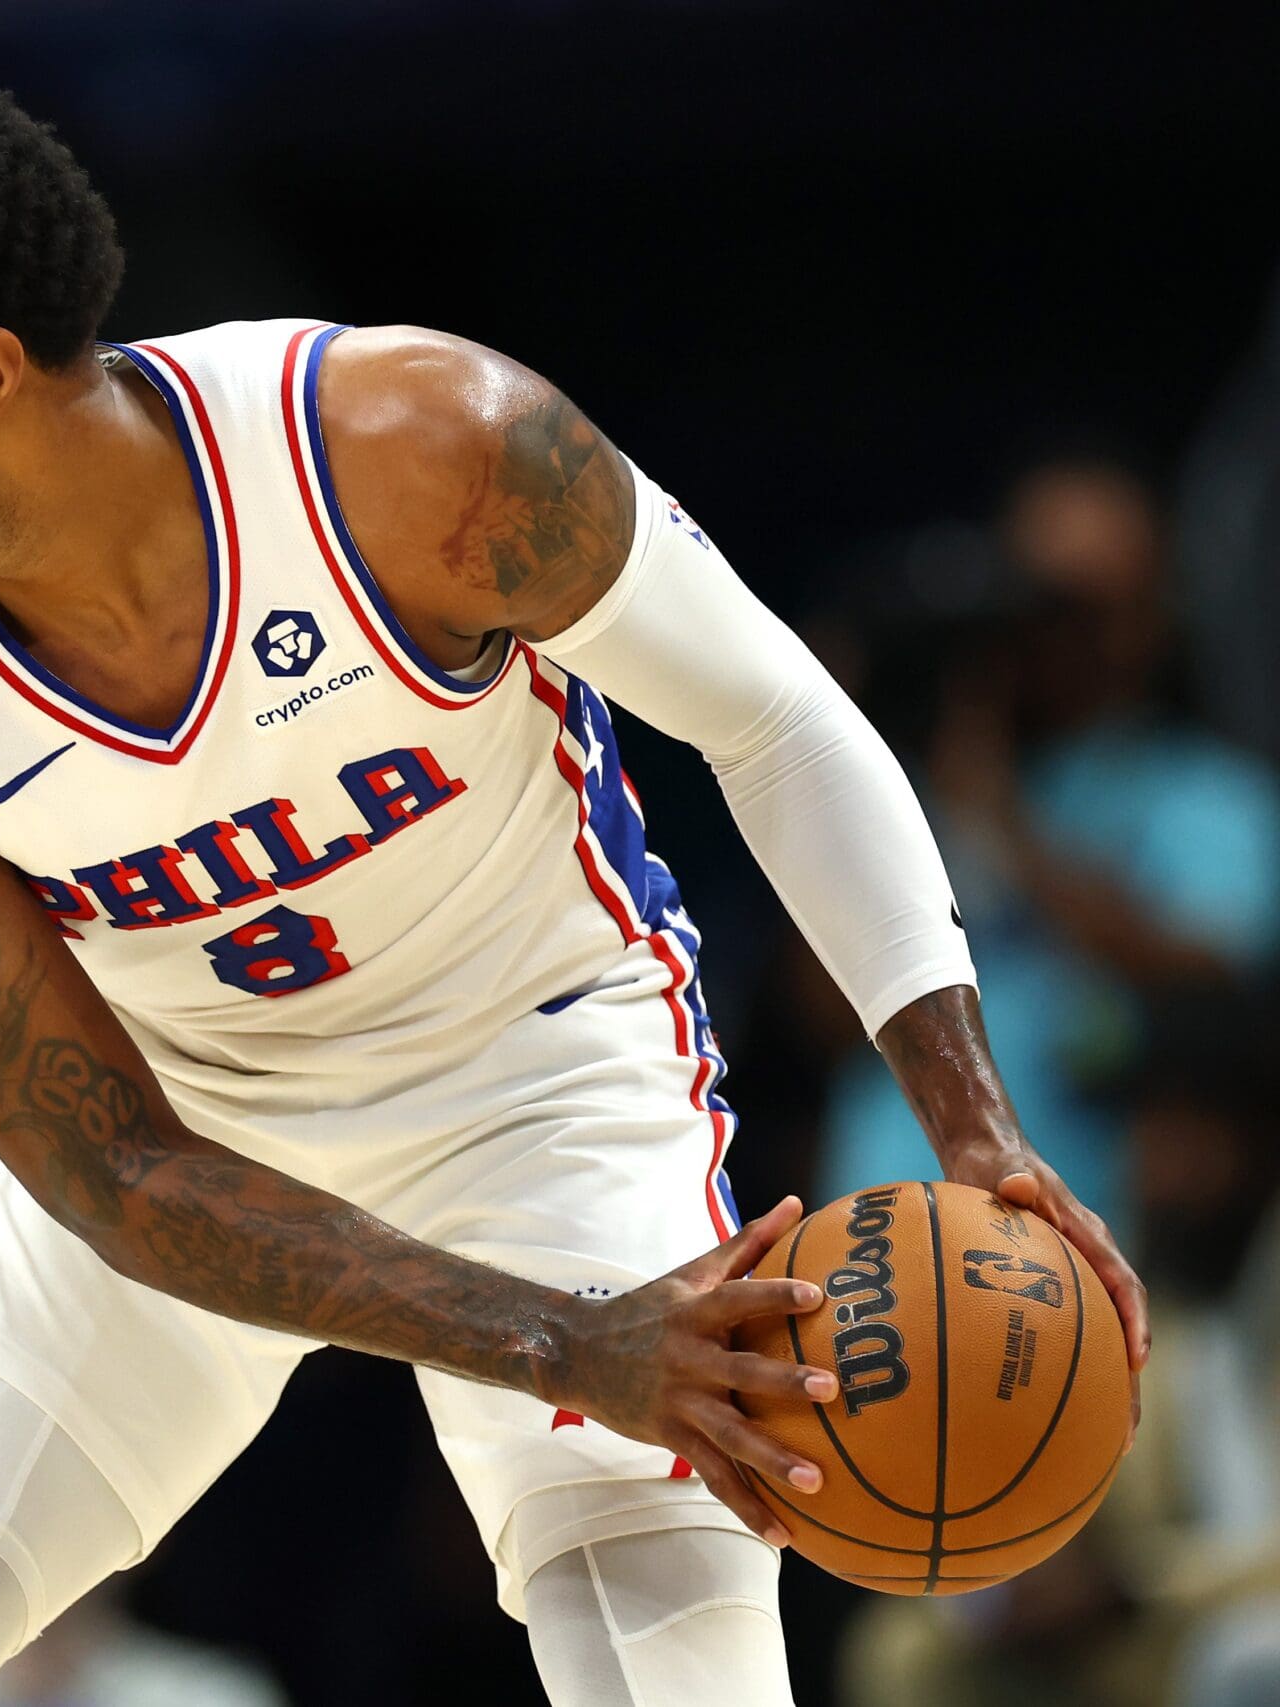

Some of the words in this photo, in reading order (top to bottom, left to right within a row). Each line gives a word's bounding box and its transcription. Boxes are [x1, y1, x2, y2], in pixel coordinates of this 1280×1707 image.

[254, 661, 375, 729] crypto.com
[26, 746, 469, 942] PHILA
[201, 903, 352, 998] 8
[824, 1186, 911, 1417] Wilson
[996, 1359, 1019, 1401] OFFICIAL
[1008, 1309, 1024, 1331] BALL
